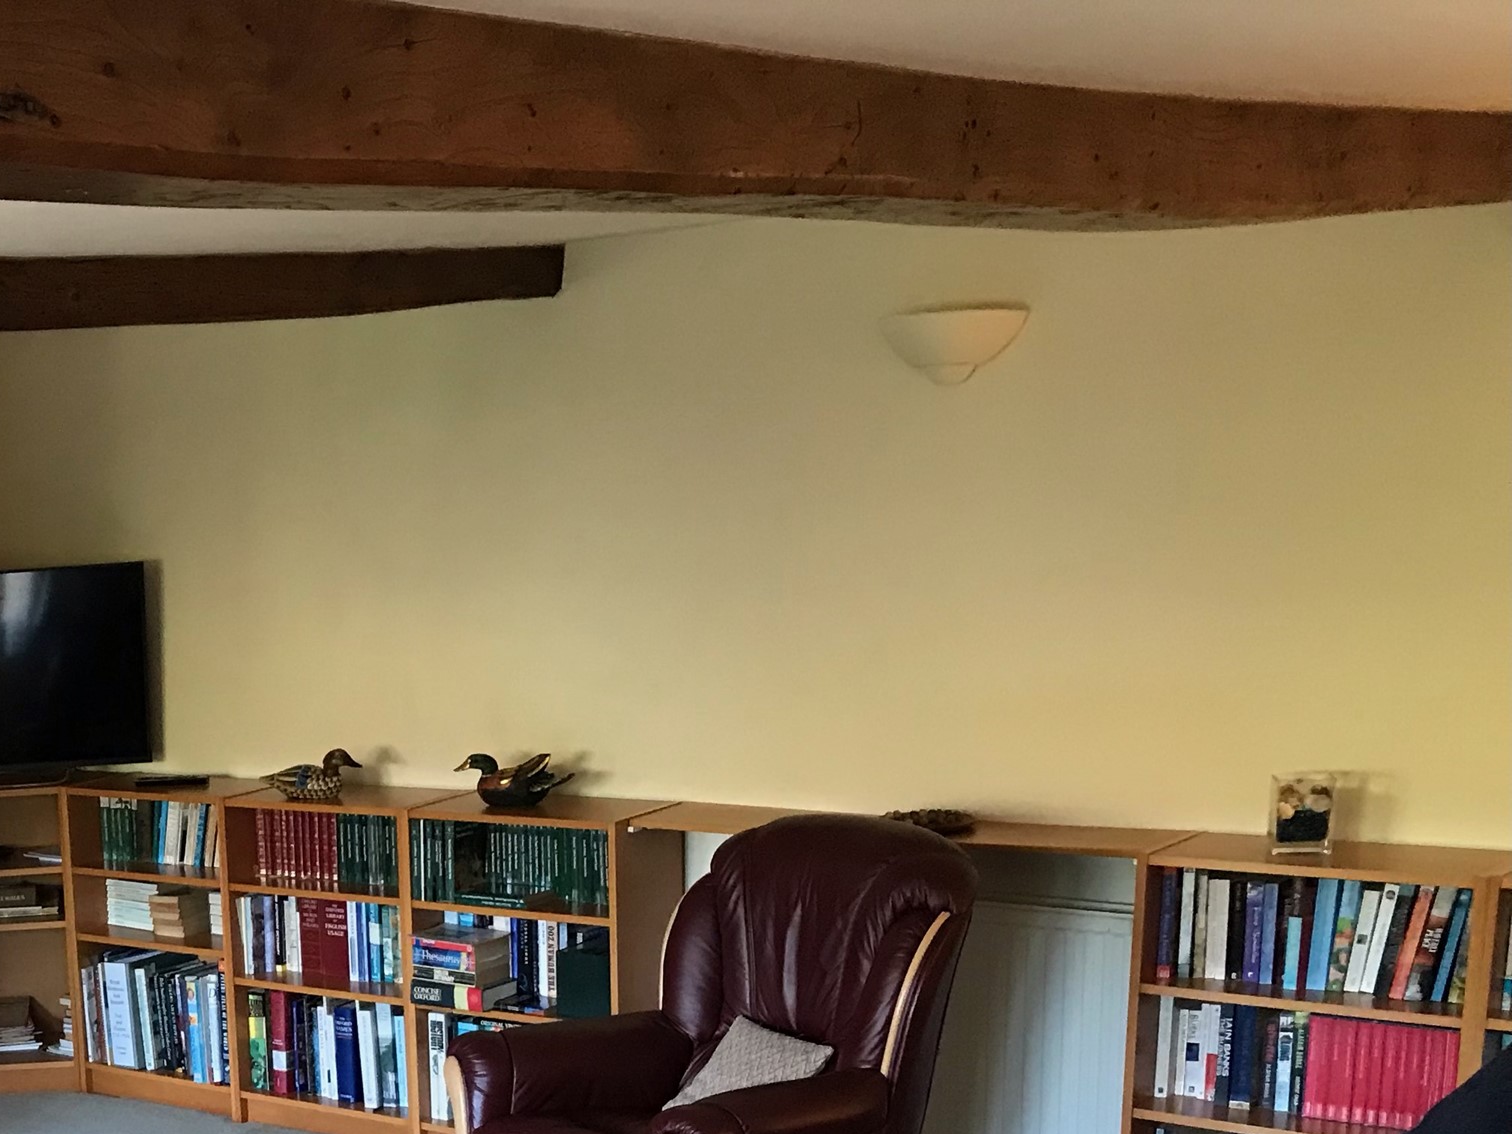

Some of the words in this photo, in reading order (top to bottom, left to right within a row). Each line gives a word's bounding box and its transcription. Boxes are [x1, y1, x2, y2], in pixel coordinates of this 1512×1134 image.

[547, 925, 555, 941] ZOO
[422, 949, 460, 964] Thesaurus
[413, 986, 441, 995] CONCISE
[413, 993, 441, 1001] OXFORD
[480, 1020, 504, 1028] ORIGINAL
[1224, 1017, 1233, 1040] IAIN
[1222, 1043, 1231, 1077] BANKS
